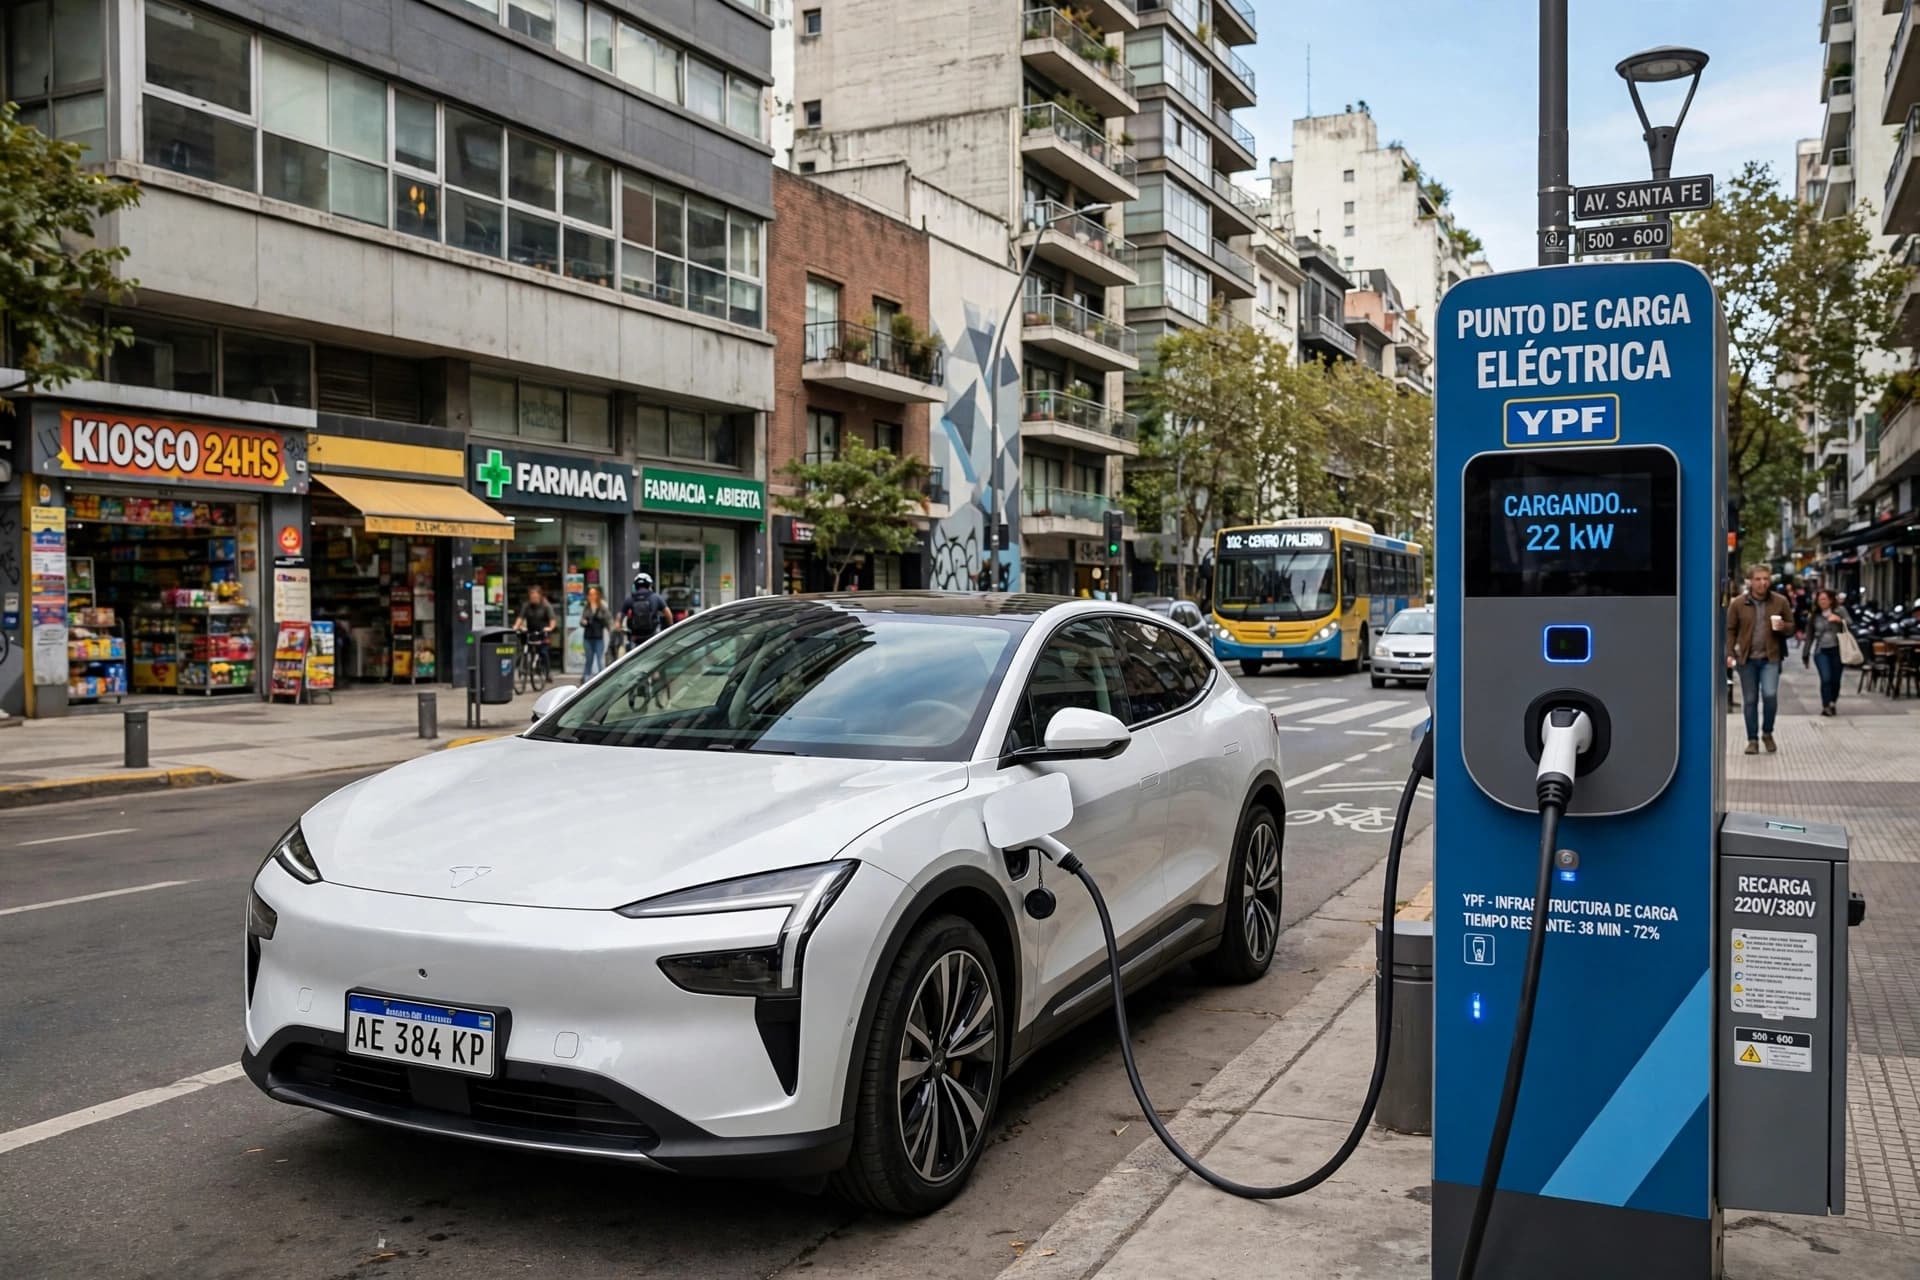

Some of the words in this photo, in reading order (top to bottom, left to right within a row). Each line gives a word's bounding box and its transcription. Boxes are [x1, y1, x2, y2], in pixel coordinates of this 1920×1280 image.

[1584, 193, 1609, 212] AV.
[1616, 186, 1674, 210] SANTA
[1681, 183, 1703, 203] FE
[1588, 232, 1615, 249] 500
[1633, 228, 1664, 246] 600
[1458, 304, 1546, 339] PUNTO
[1553, 300, 1588, 333] DE
[1595, 293, 1692, 330] CARGA
[1477, 340, 1671, 389] ELÉCTRICA
[1516, 406, 1606, 436] YPF
[71, 418, 200, 473] KIOSCO
[203, 432, 280, 479] 24HS
[517, 462, 628, 503] FARMACIA
[644, 478, 706, 505] FARMACIA
[715, 486, 761, 511] ABIERTA
[1503, 492, 1638, 517] CARGANDO...
[1526, 524, 1561, 551] 22
[1569, 523, 1614, 550] kW
[1738, 876, 1812, 896] RECARGA
[1462, 893, 1486, 907] YPF
[1495, 895, 1612, 917] INFRATRUCTURA
[1615, 903, 1632, 918] DE
[1634, 905, 1679, 921] CARGA
[1734, 896, 1816, 918] 220V/380V
[1463, 912, 1508, 929] TIEMPO
[1578, 920, 1594, 935] 38
[1597, 921, 1621, 937] MIN
[1633, 924, 1660, 940] 72%
[355, 1016, 384, 1051] AE
[395, 1021, 442, 1061] 384
[452, 1029, 484, 1066] KP
